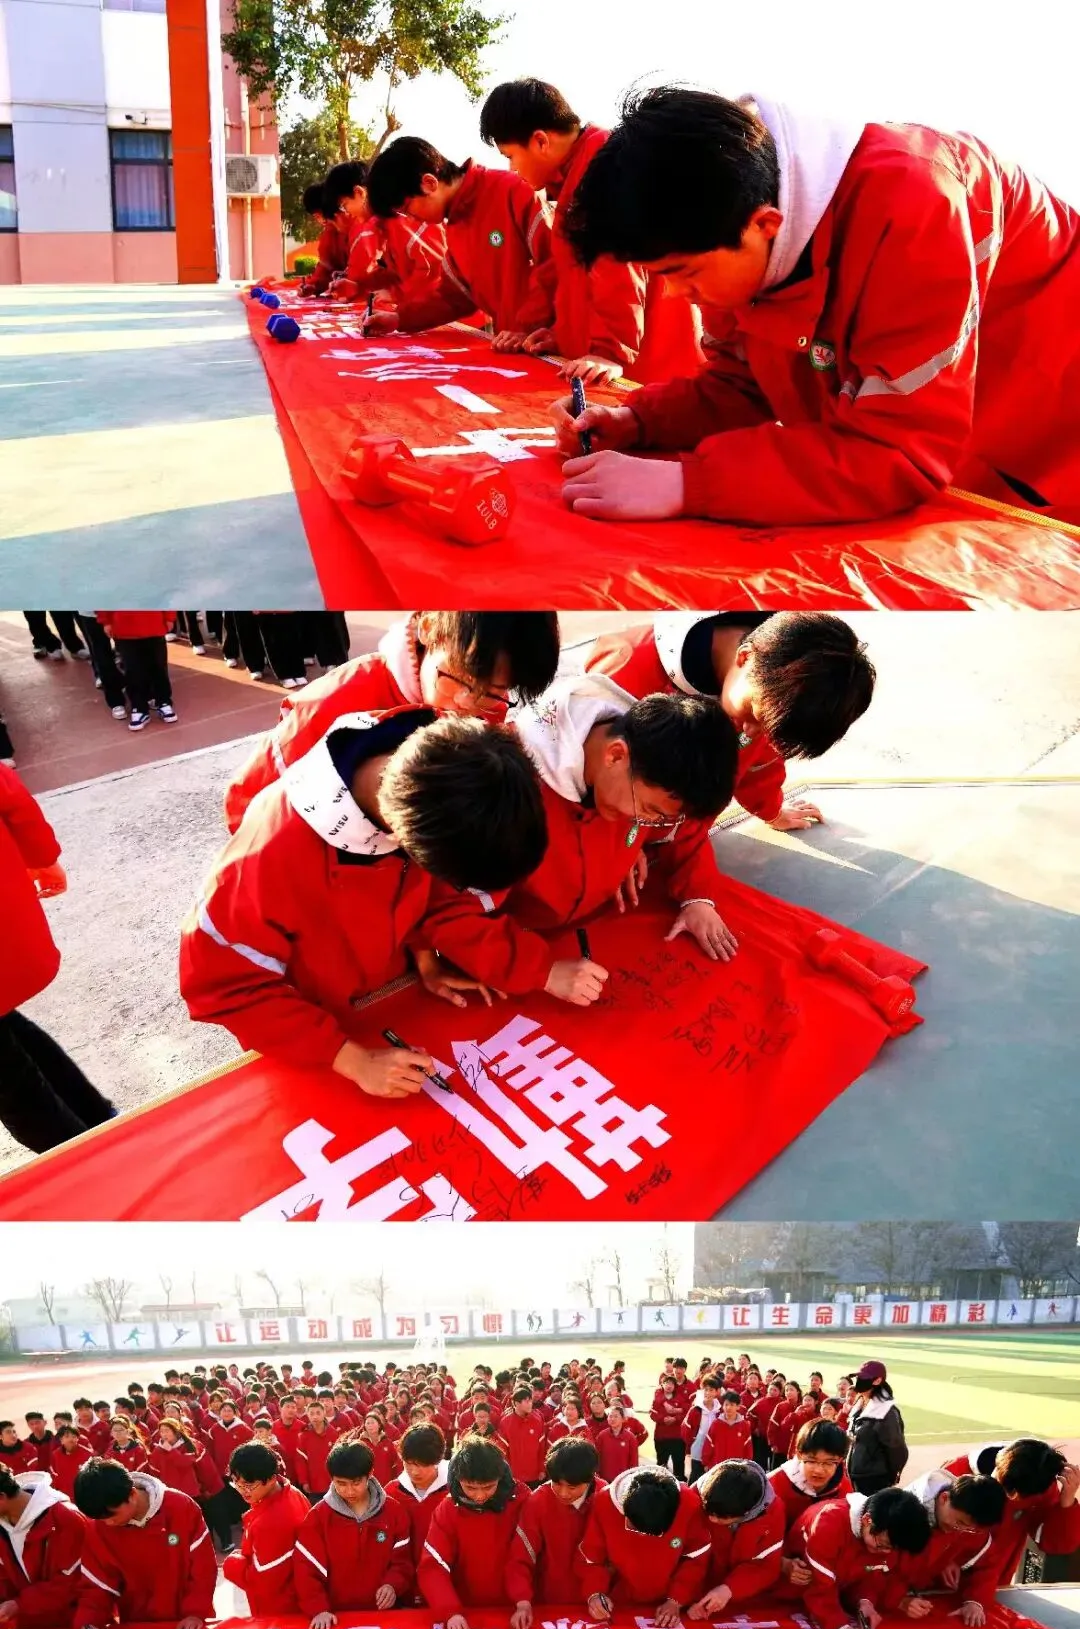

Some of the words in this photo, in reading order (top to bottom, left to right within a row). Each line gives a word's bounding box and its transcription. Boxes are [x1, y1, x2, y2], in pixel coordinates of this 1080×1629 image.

[333, 786, 349, 804] EVIS
[328, 814, 349, 836] EVISU
[732, 1303, 985, 1327] 让生命更加精彩
[215, 1313, 503, 1343] 让运动成为习惯
